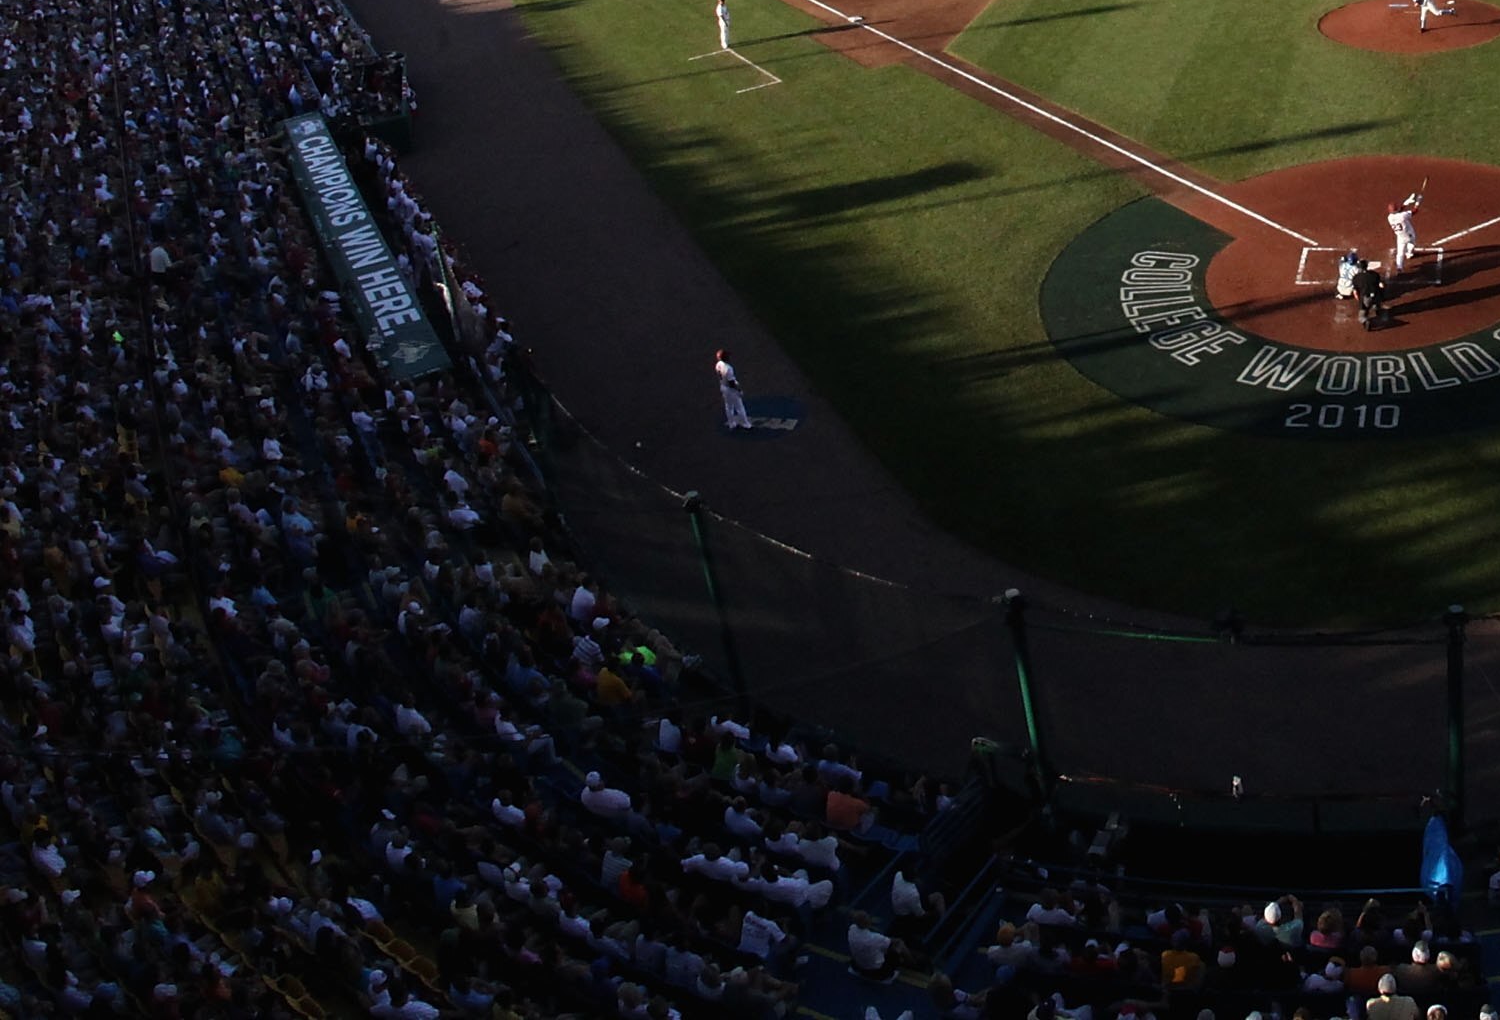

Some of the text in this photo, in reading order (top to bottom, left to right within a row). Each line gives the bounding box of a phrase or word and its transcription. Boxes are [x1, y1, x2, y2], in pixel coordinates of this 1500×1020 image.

[297, 135, 367, 228] CHAMPIONS
[338, 223, 389, 270] WIN
[357, 266, 422, 338] HERE.
[1120, 250, 1247, 367] COLLEGE
[1284, 403, 1401, 429] 2010
